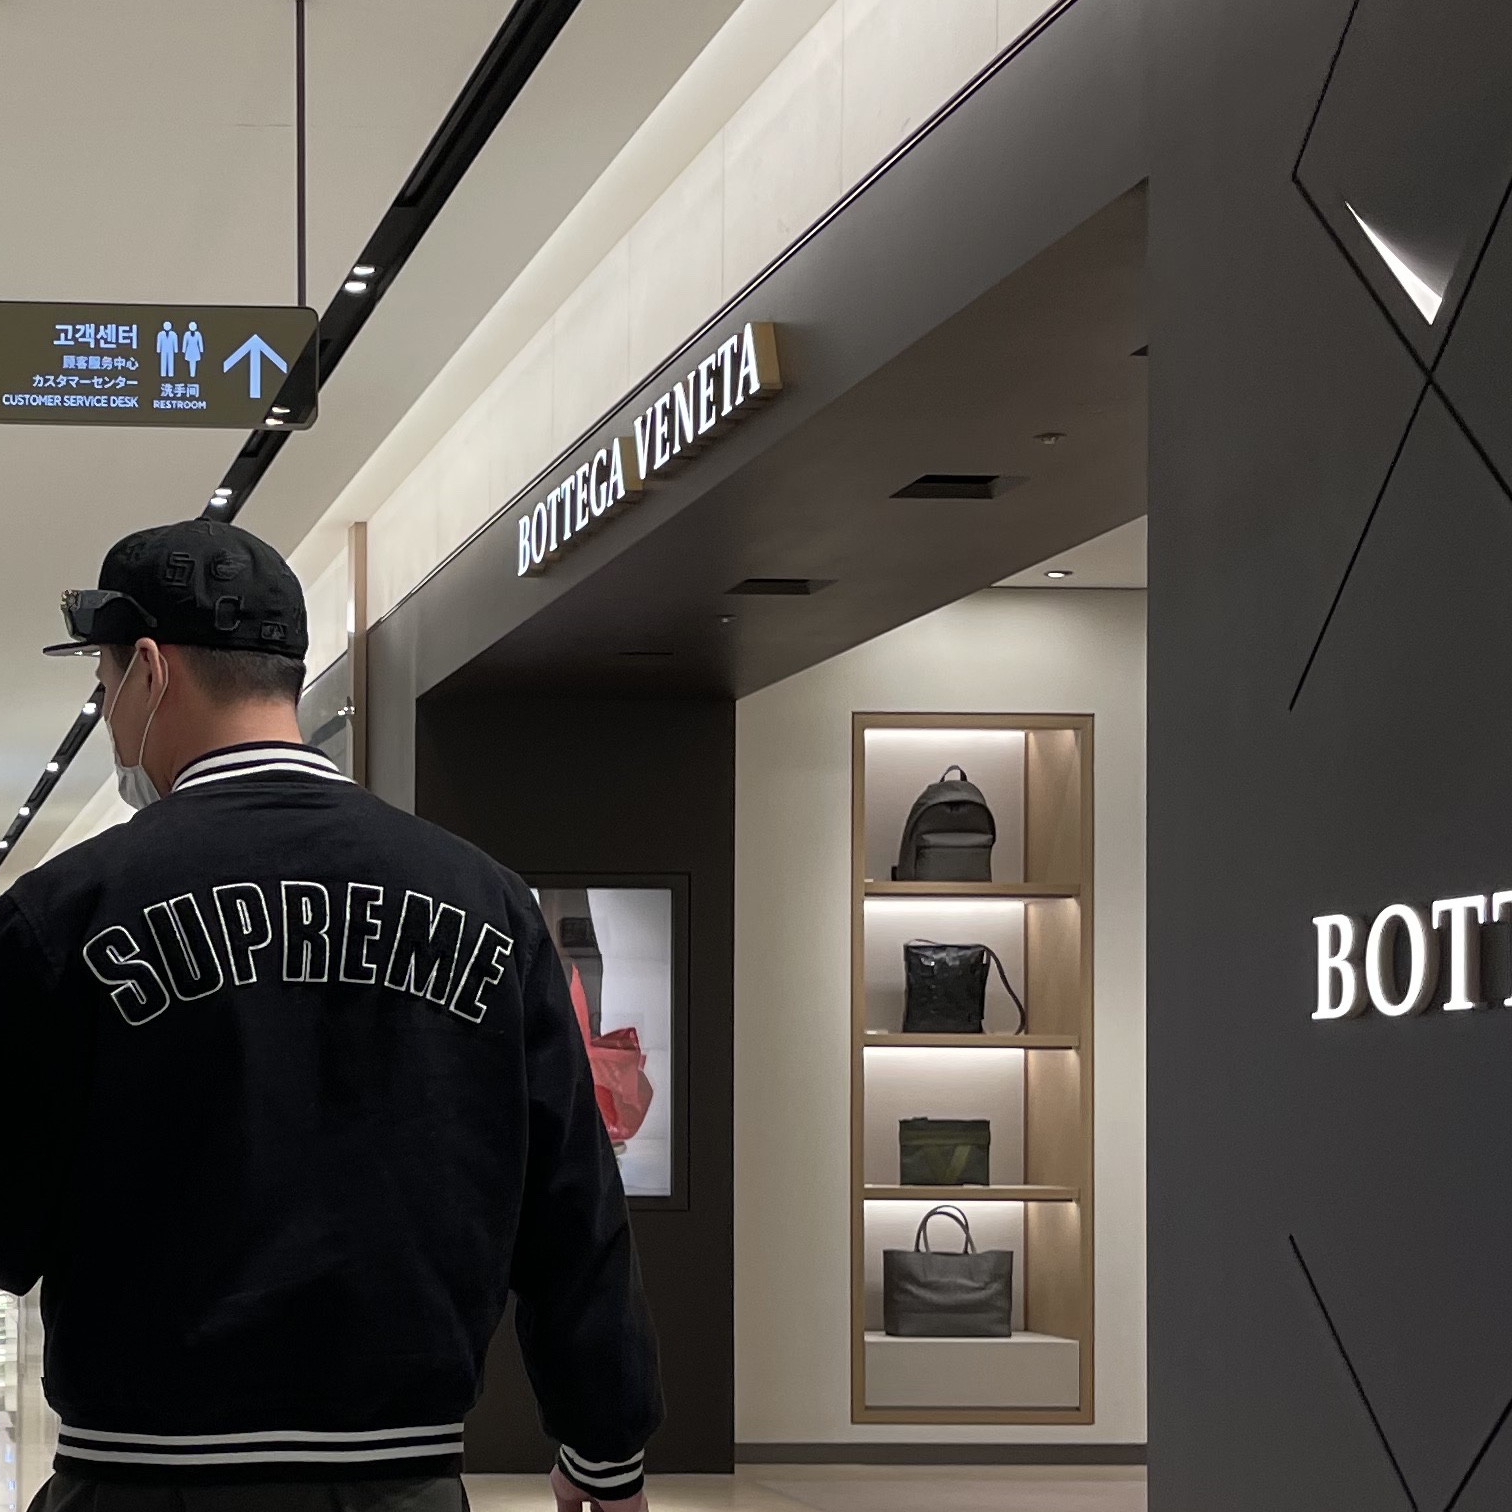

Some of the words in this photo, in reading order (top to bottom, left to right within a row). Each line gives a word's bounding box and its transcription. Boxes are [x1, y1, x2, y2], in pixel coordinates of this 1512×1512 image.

[53, 323, 138, 349] 고객센터
[32, 374, 139, 389] カスタマーセンター
[160, 383, 200, 398] 洗手间
[2, 393, 62, 407] CUSTOMER
[63, 395, 109, 408] SERVICE
[109, 395, 139, 409] DESK
[153, 400, 207, 410] RESTROOM
[518, 437, 626, 577] BOTTEGA
[633, 322, 760, 480] VENETA
[83, 880, 514, 1026] SUPREME
